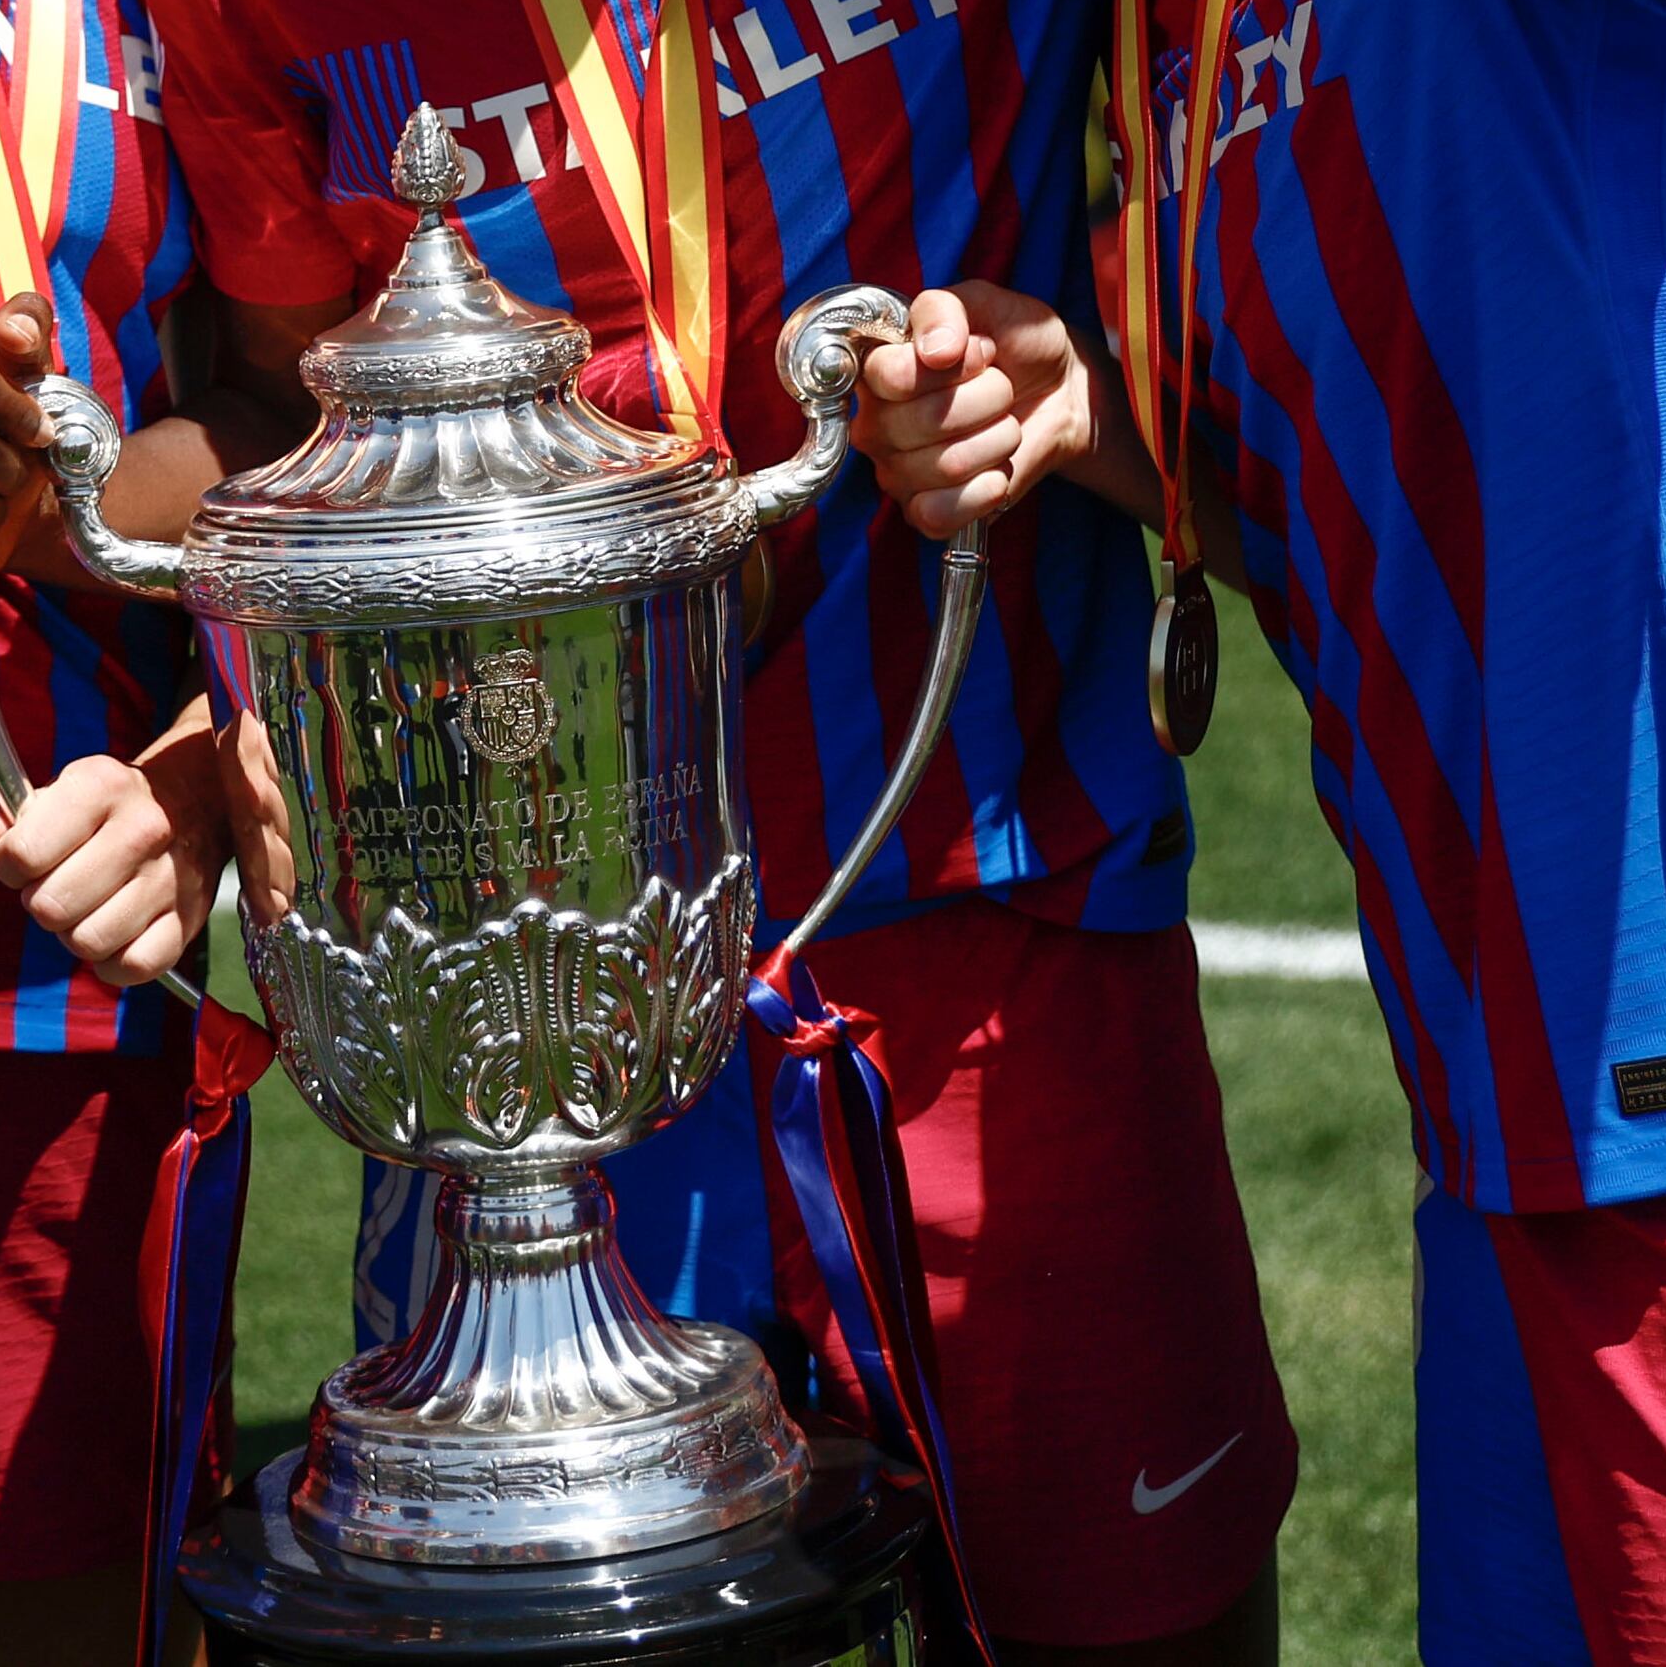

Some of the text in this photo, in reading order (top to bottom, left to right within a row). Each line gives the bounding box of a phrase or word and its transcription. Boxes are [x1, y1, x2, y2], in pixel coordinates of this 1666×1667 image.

[332, 795, 537, 837] AMPEONATO
[544, 787, 593, 824] DE
[416, 843, 465, 877] DE
[551, 829, 596, 865] LA
